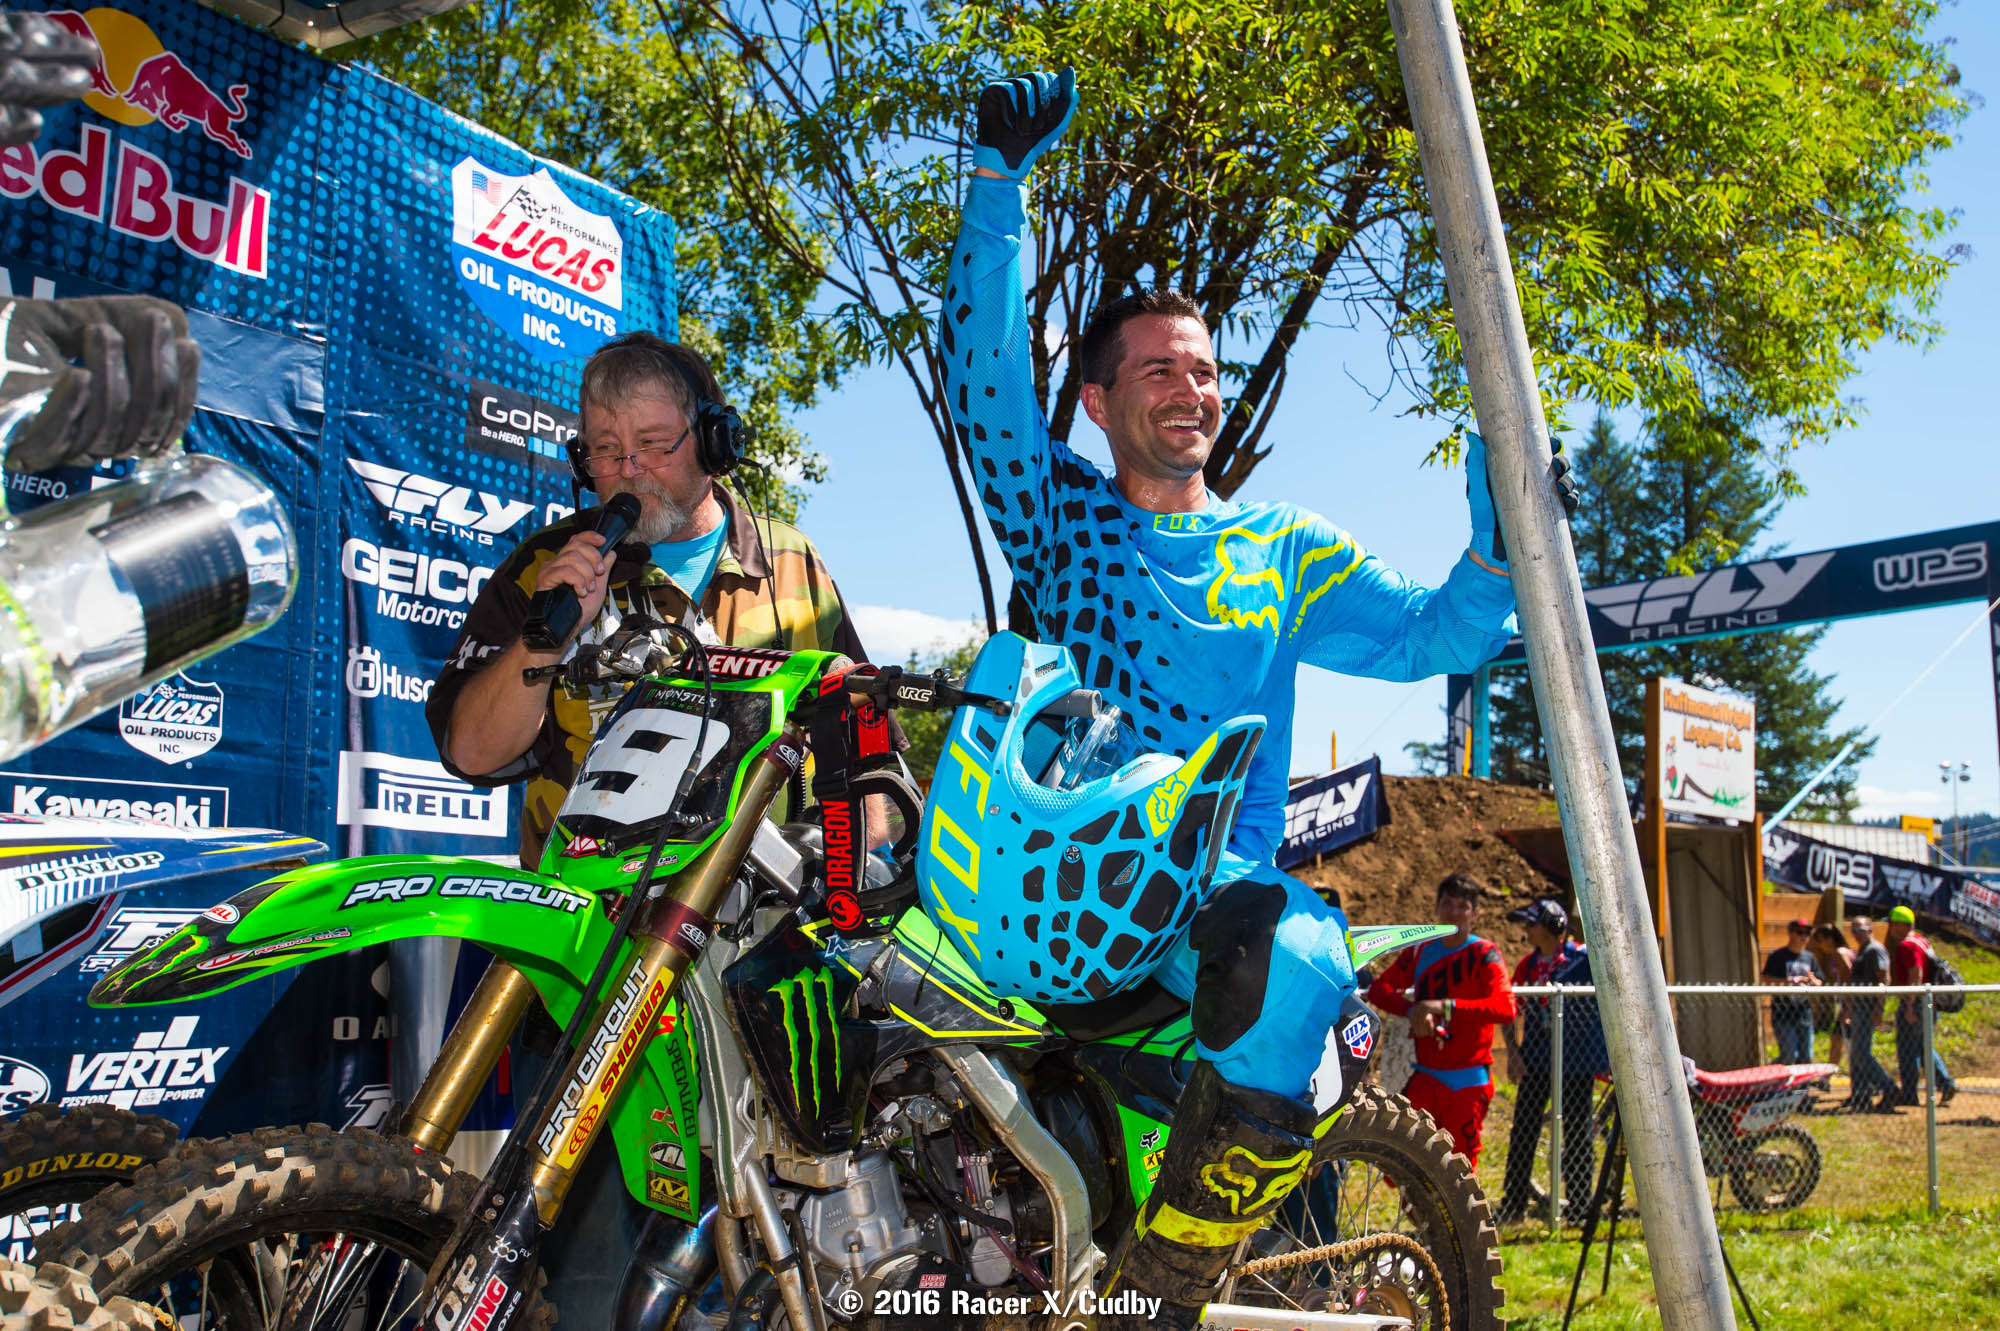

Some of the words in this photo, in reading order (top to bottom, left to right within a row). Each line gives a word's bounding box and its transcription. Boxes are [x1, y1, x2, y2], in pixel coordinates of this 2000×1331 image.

[110, 140, 271, 279] Bull
[472, 211, 615, 293] LUCAS
[550, 217, 620, 256] PERFORMANCE
[460, 256, 500, 291] OIL
[507, 273, 617, 337] PRODUCTS
[522, 313, 566, 349] INC.
[481, 426, 491, 438] Be
[498, 430, 526, 448] HERO.
[11, 473, 70, 500] HERO.
[347, 457, 536, 534] FLY
[388, 511, 494, 546] RACING
[1152, 515, 1202, 532] FOX
[1873, 541, 1988, 592] WPS
[1629, 609, 1779, 642] RACING
[131, 697, 218, 726] LUCAS
[124, 724, 147, 737] OIL
[151, 726, 217, 742] PRODUCTS
[159, 743, 184, 755] INC.
[1683, 719, 1724, 753] Logging
[13, 785, 211, 829] Kawasaki
[822, 799, 853, 888] DRAGON
[1289, 814, 1357, 849] RACING
[930, 741, 992, 962] FOX
[17, 851, 164, 892] DUNLOP
[337, 874, 436, 911] PRO
[438, 874, 594, 914] CIRCUIT
[537, 1079, 584, 1157] PRO
[576, 956, 650, 1086] CIRCUIT
[601, 979, 665, 1100] SHOWA
[66, 1046, 231, 1093] VERTEX
[665, 1038, 696, 1138] SPECIALIZED
[59, 1095, 108, 1108] PISTON
[162, 1088, 206, 1101] POWER
[0, 1152, 143, 1191] DUNLOP
